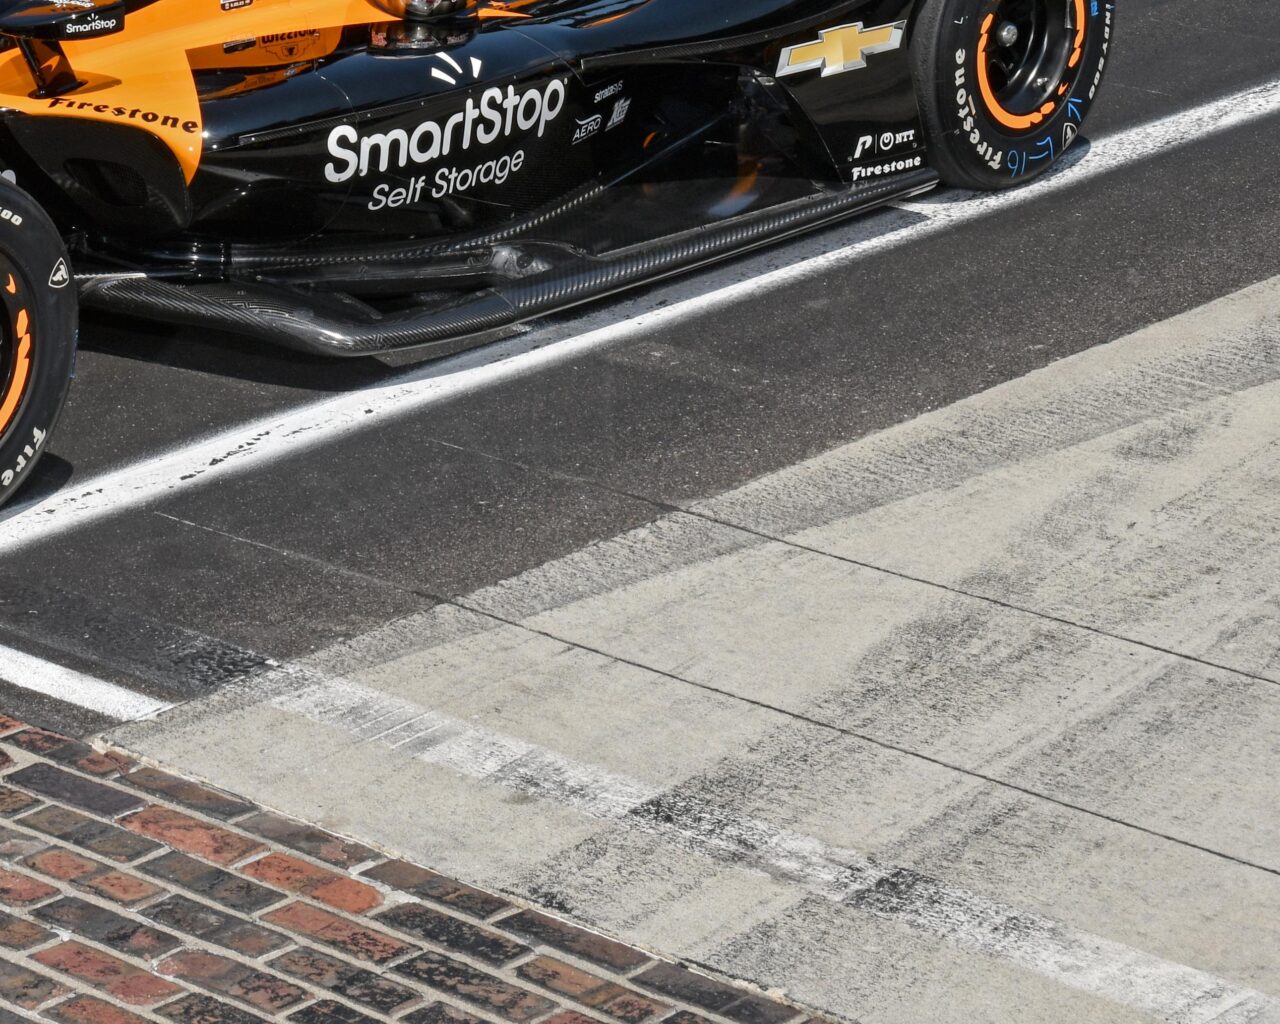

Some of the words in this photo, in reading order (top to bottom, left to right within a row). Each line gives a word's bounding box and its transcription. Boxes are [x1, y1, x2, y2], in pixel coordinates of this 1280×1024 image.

[66, 18, 117, 33] SmartStop
[47, 97, 200, 134] Firestone
[954, 47, 1004, 170] Firestone
[324, 77, 566, 183] SmartStop
[572, 118, 602, 142] AERO
[895, 129, 915, 144] NTT
[368, 176, 425, 210] Self
[431, 149, 524, 199] Storage
[851, 156, 921, 181] Firestone
